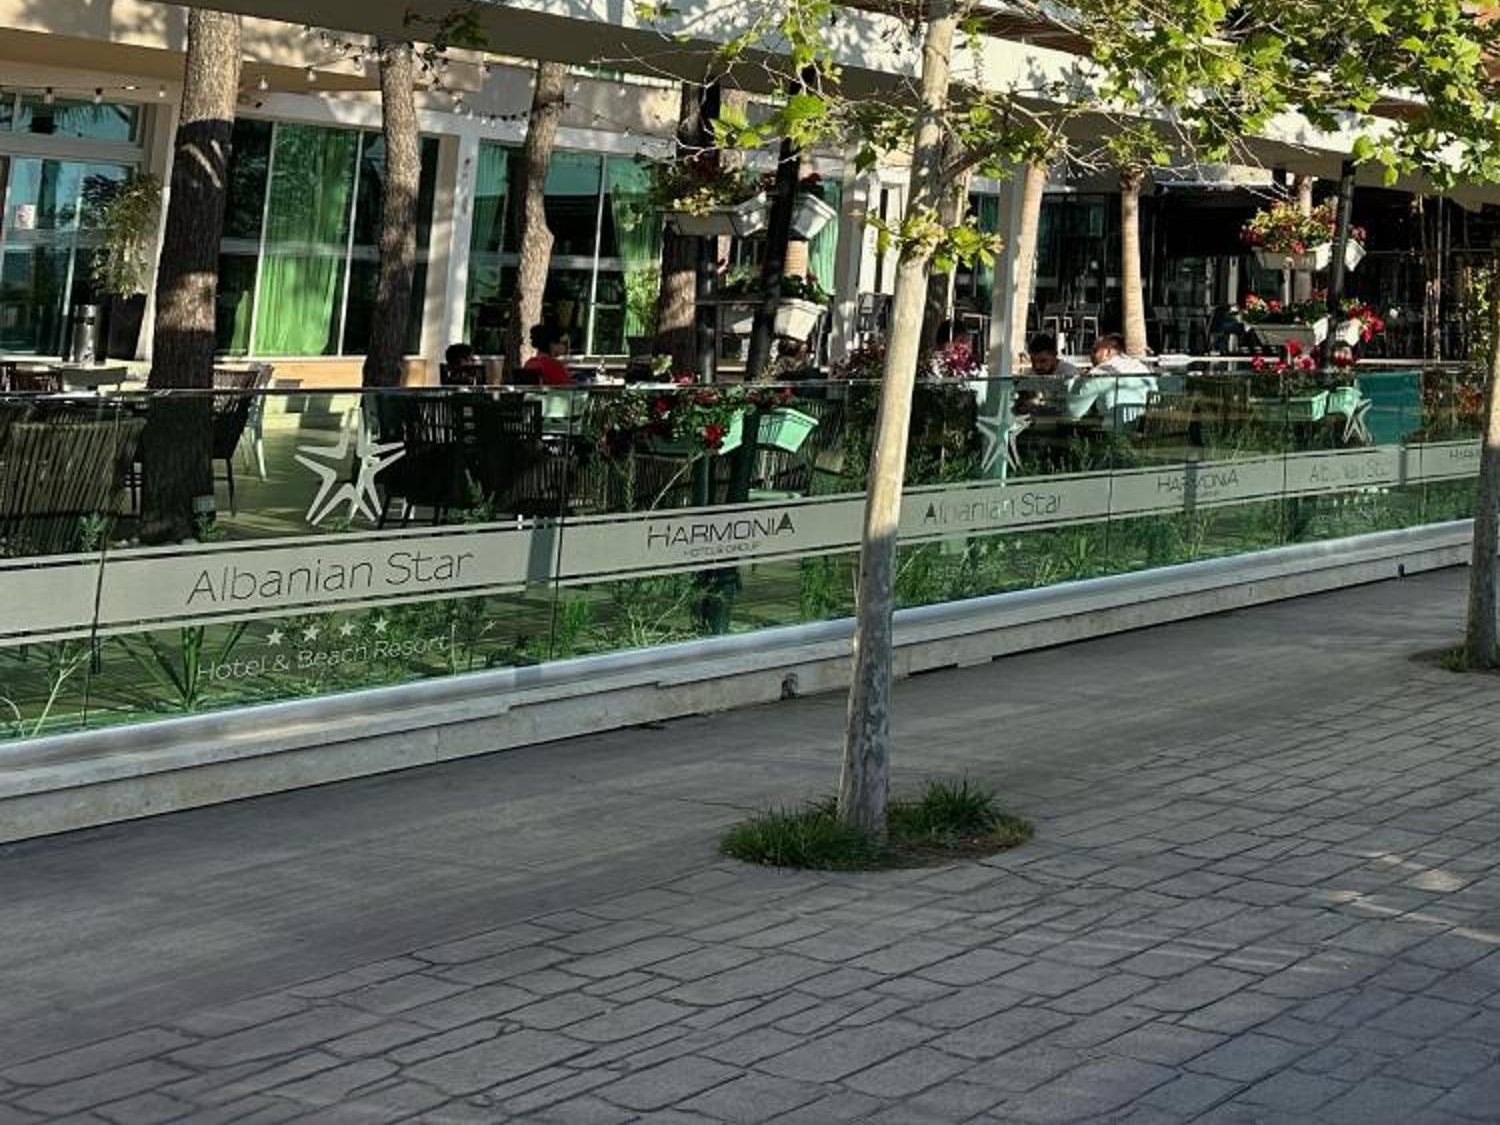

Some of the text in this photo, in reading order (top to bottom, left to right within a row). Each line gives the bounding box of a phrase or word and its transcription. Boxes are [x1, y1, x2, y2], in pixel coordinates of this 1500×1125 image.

[647, 512, 795, 549] HARMONIA
[186, 550, 474, 605] Albanian Star
[197, 634, 450, 681] Hotel & Beach Resort
